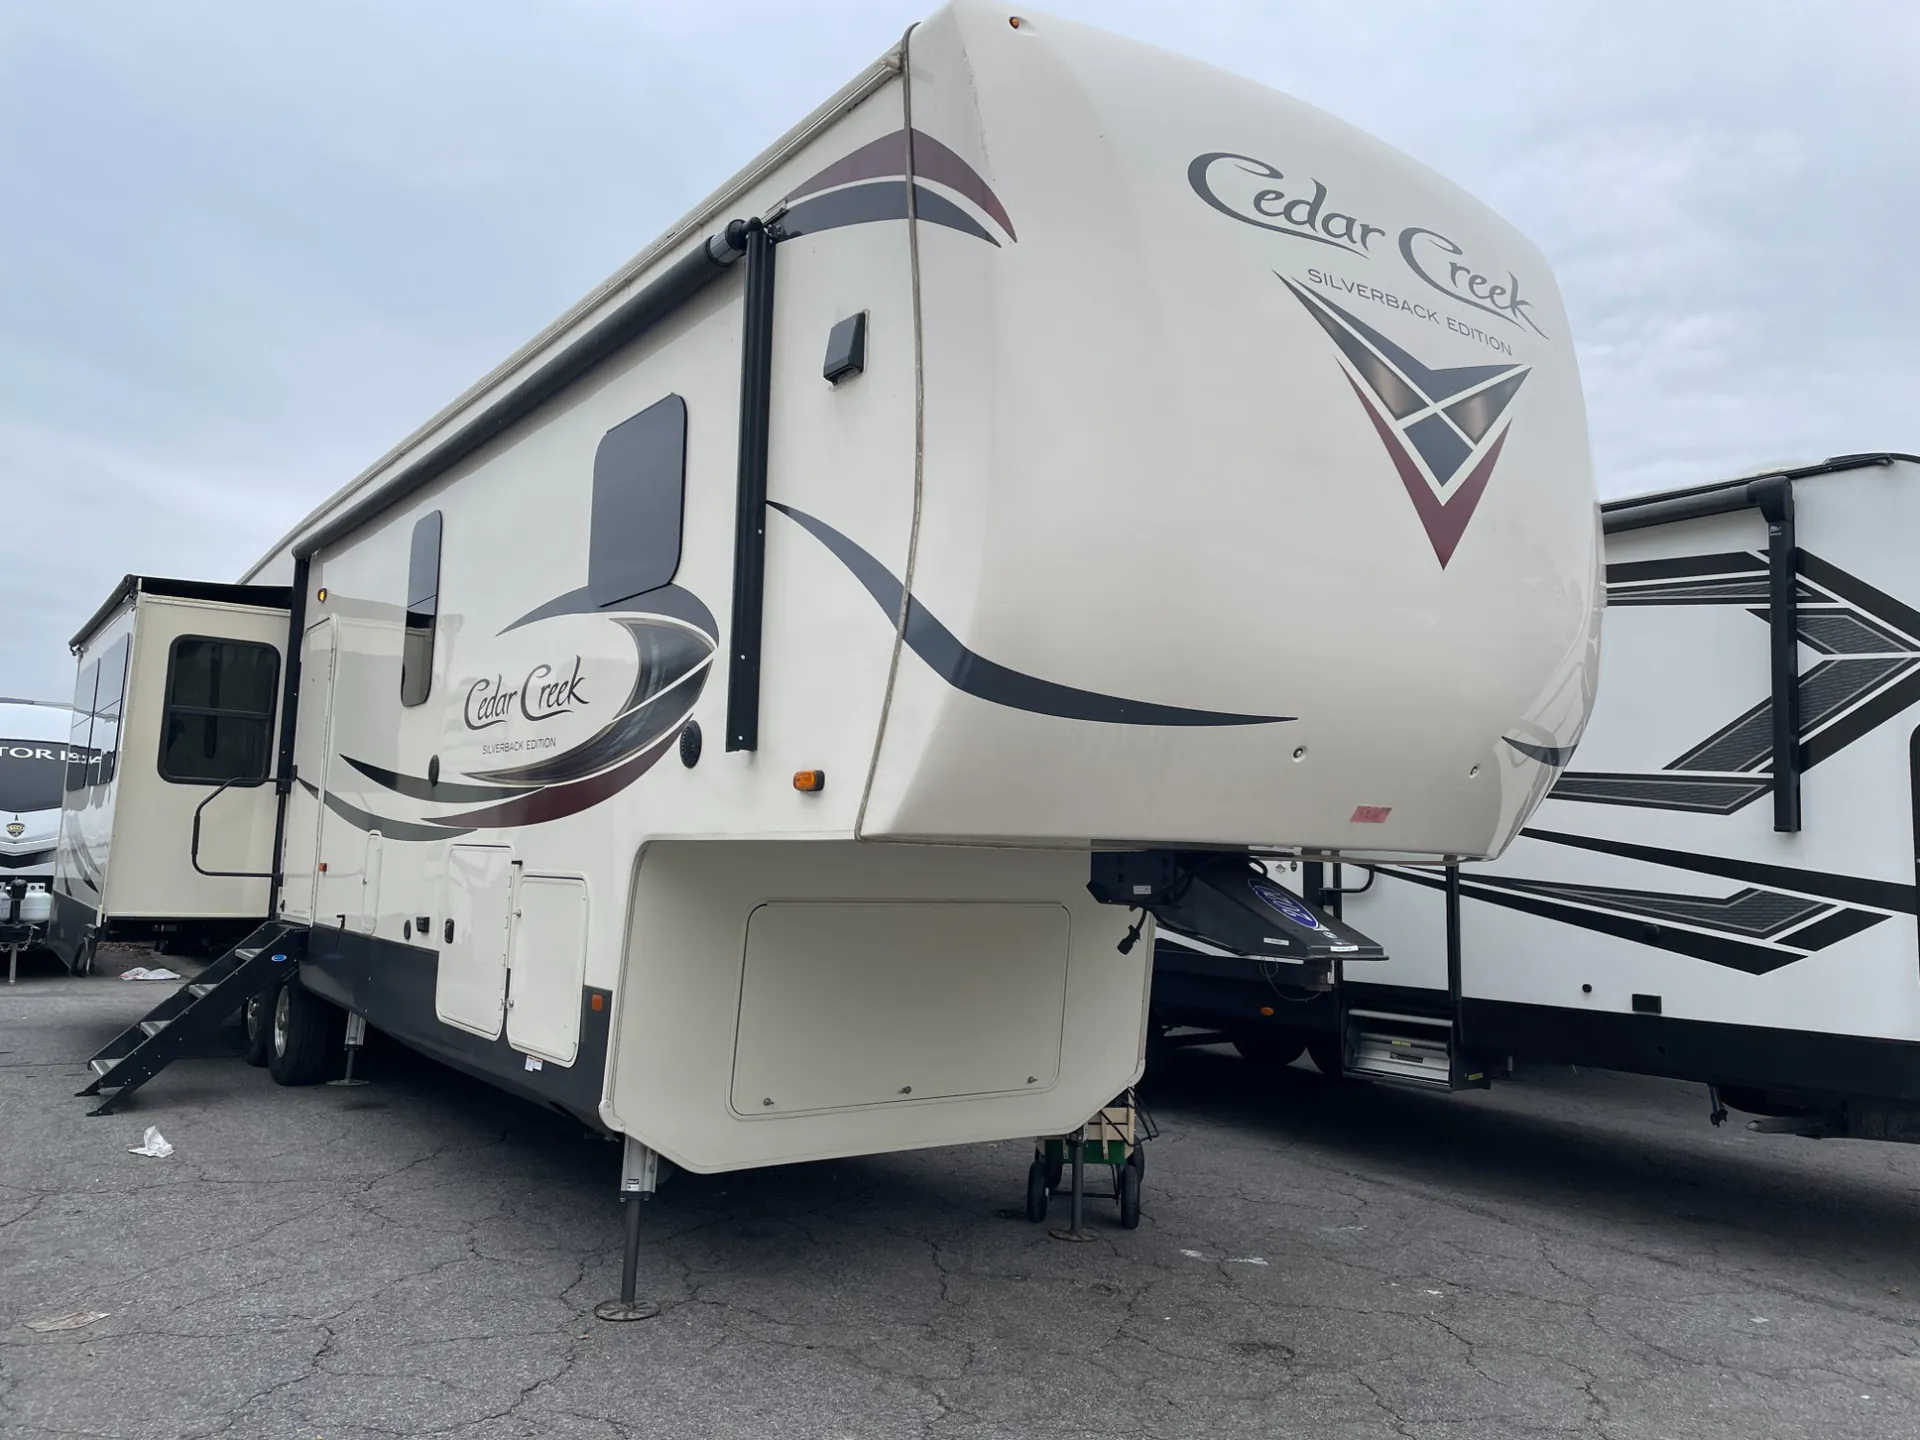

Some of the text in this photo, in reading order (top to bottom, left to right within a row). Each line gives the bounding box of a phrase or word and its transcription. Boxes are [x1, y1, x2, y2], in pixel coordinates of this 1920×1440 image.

[1187, 152, 1550, 340] Cedar Creek
[1307, 268, 1513, 357] SILVERBACK EDITION
[463, 654, 590, 731] Cedar Creek
[482, 737, 557, 755] SILVERBACK EDITION
